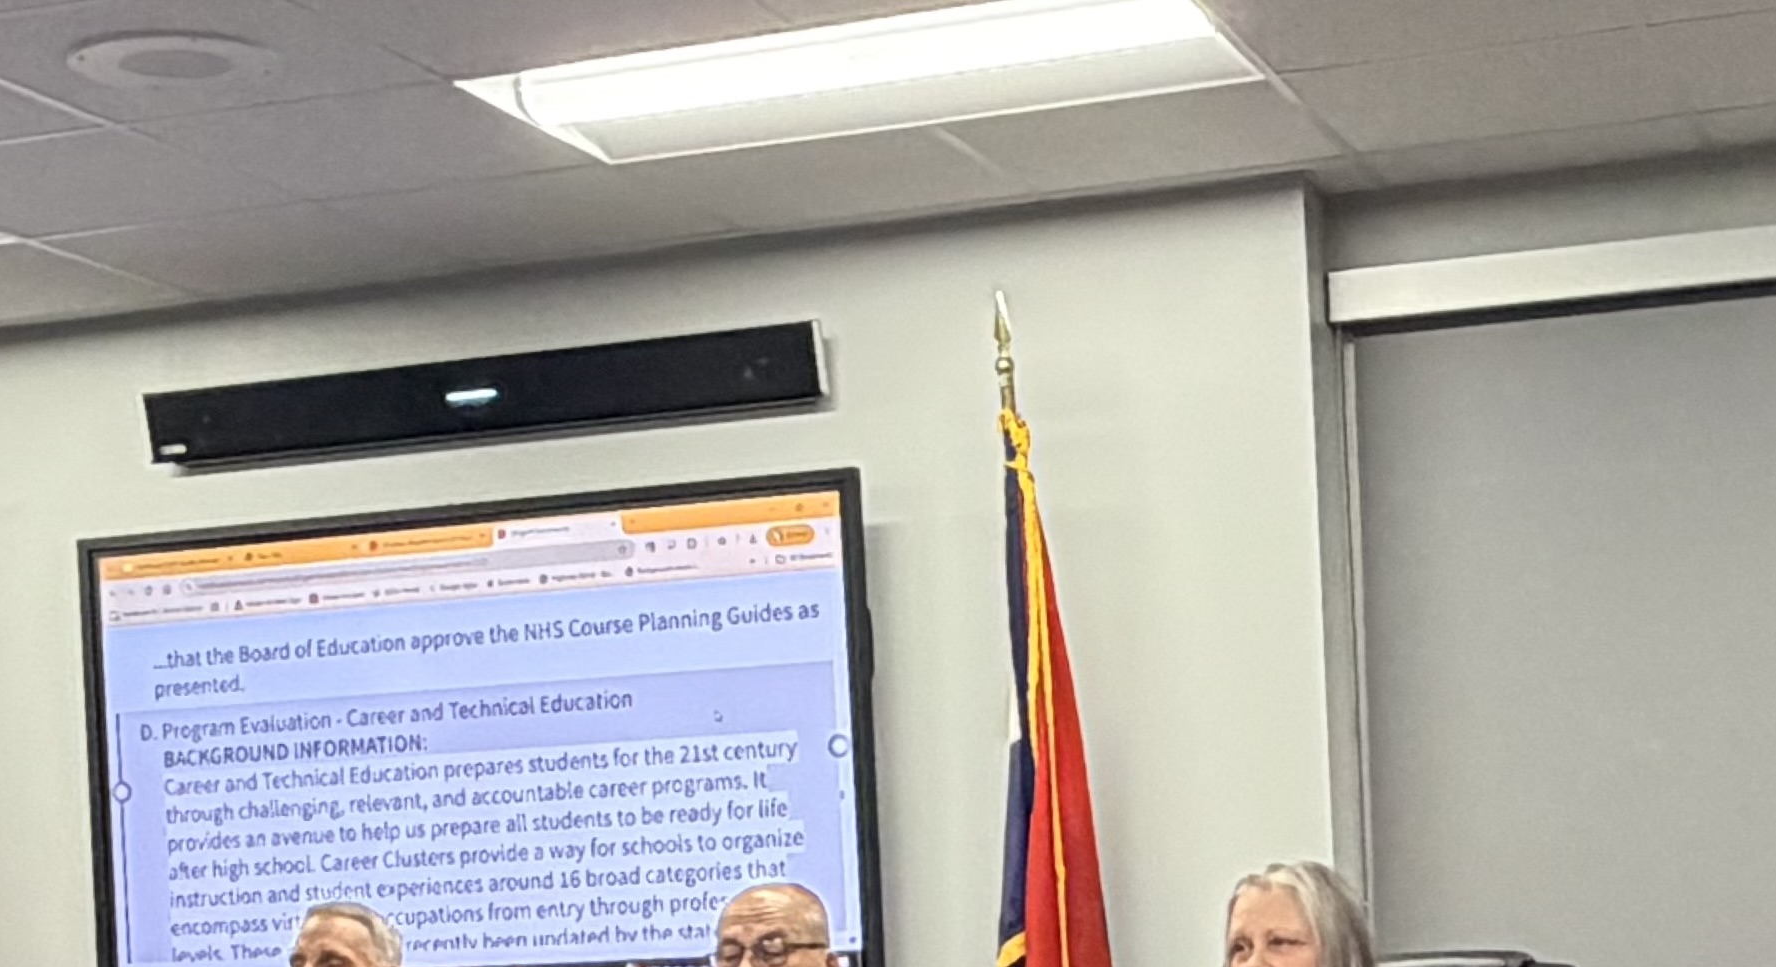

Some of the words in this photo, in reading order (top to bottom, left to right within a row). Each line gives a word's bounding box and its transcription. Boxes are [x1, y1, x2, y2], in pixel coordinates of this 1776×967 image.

[205, 647, 233, 665] the
[238, 642, 290, 663] Board
[294, 638, 312, 658] of
[316, 636, 405, 657] Education
[410, 630, 484, 653] approve
[489, 624, 518, 643] the
[523, 619, 564, 640] NHS
[568, 617, 633, 637] Course
[638, 608, 722, 632] Planning
[726, 602, 793, 625] Guides
[798, 603, 819, 619] as
[154, 674, 244, 701] presented.
[139, 723, 157, 741] D.
[161, 721, 235, 742] Program
[239, 712, 331, 735] Evaluation
[346, 708, 404, 727] Career
[410, 701, 443, 722] and
[448, 696, 534, 719] Technical
[540, 690, 632, 713] Education
[163, 742, 289, 768] BACKGROUND
[293, 734, 427, 759] INFORMATION:
[164, 778, 220, 796] Career
[224, 772, 257, 792] and
[261, 766, 344, 790] Technical
[349, 762, 438, 784] Education
[443, 758, 523, 782] prepares
[528, 751, 609, 773] students
[612, 747, 638, 767] for
[644, 745, 674, 765] the
[679, 743, 719, 763] 21st
[723, 741, 797, 762] century
[165, 802, 234, 826] through
[237, 797, 344, 821] challenging,
[349, 792, 427, 813] relevant,
[432, 787, 466, 808] and
[471, 780, 583, 805] accountable
[588, 780, 647, 798] career
[651, 774, 748, 799] programs.
[753, 770, 767, 788] It
[167, 831, 240, 855] provides
[245, 832, 265, 848] an
[270, 829, 335, 846] avenue
[339, 826, 356, 842] to
[361, 820, 400, 843] help
[405, 823, 425, 838] us
[430, 819, 500, 841] prepare
[506, 812, 527, 832] all
[532, 810, 612, 831] students
[616, 810, 636, 827] to
[640, 805, 664, 825] be
[669, 801, 722, 826] ready
[726, 799, 753, 820] for
[758, 797, 787, 818] life
[168, 861, 207, 880] after
[211, 858, 249, 881] high
[253, 854, 315, 875] school.
[320, 853, 378, 872] Career
[382, 849, 455, 868] Clusters
[459, 843, 528, 869] provide
[534, 846, 543, 860] a
[548, 844, 585, 863] way
[590, 836, 615, 857] for
[621, 833, 692, 856] schools
[697, 834, 716, 852] to
[721, 828, 804, 854] organize
[170, 888, 262, 908] instruction
[267, 883, 299, 903] and
[305, 881, 372, 903] student
[376, 876, 483, 900] experiences
[488, 870, 554, 892] around
[560, 869, 581, 888] 16
[585, 865, 640, 887] broad
[645, 861, 742, 886] categories
[747, 859, 785, 879] that
[170, 918, 268, 937] encompass
[383, 905, 483, 930] ccupations
[487, 901, 531, 920] from
[535, 901, 584, 921] entry
[589, 894, 663, 918] through
